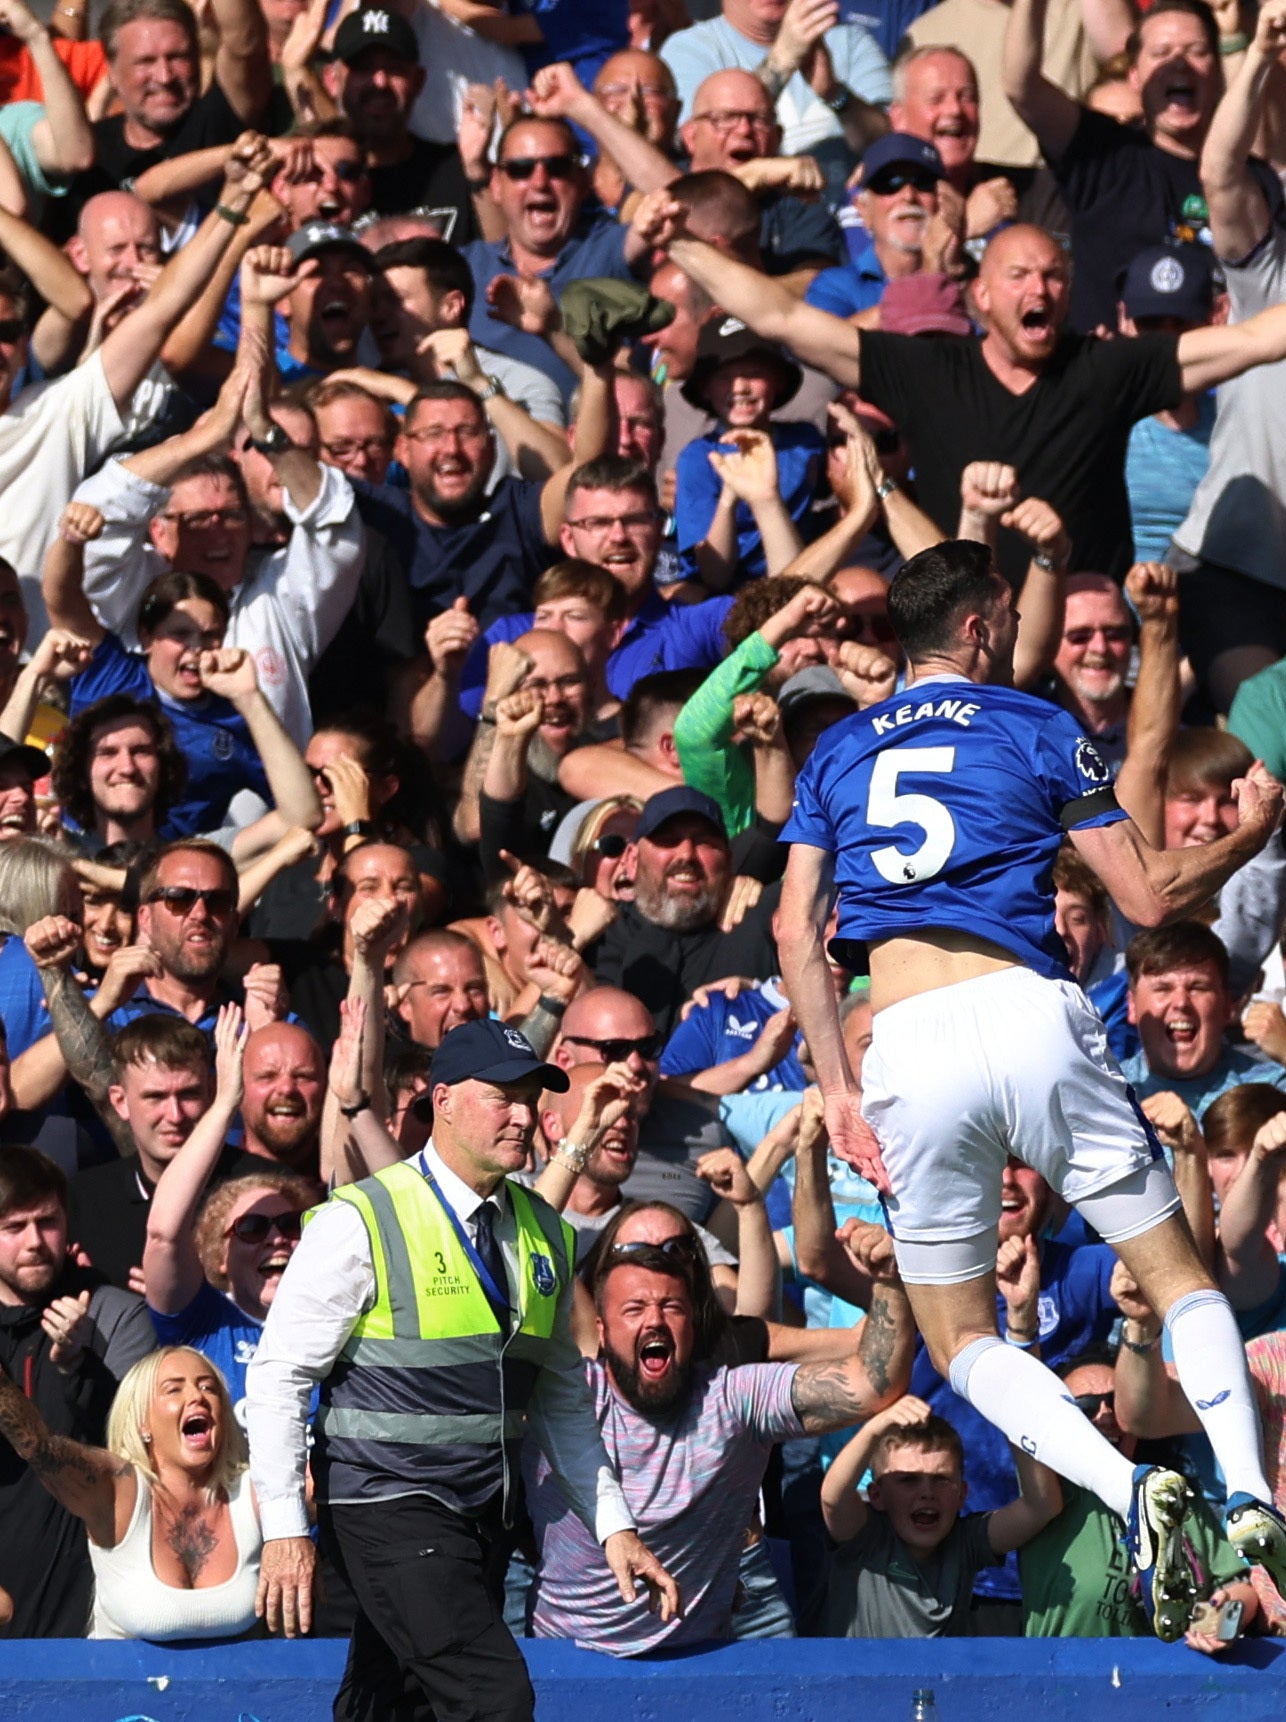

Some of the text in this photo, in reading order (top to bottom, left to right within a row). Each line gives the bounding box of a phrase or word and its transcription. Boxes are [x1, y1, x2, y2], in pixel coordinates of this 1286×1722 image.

[871, 700, 981, 736] KEANE
[866, 747, 956, 885] 5
[434, 1251, 447, 1274] 3
[425, 1286, 469, 1297] SECURITY
[433, 1276, 461, 1285] PITCH
